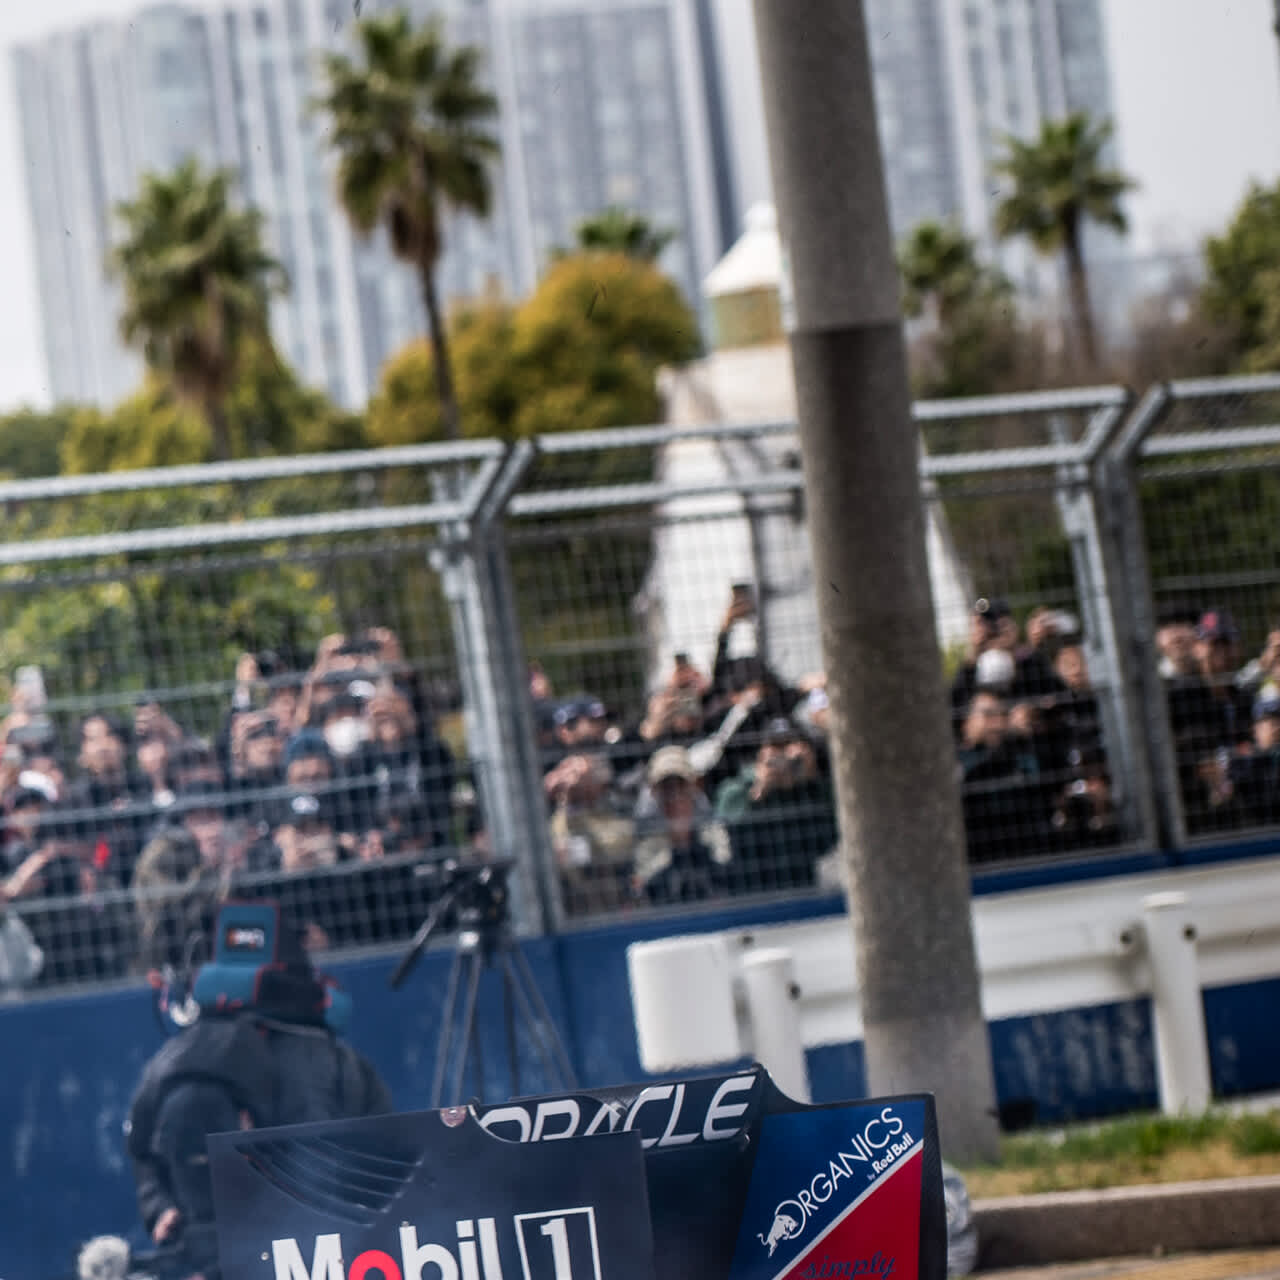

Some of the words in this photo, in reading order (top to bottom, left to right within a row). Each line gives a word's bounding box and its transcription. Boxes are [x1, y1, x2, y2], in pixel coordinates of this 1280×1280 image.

[775, 1107, 903, 1239] ORGANICS
[872, 1149, 895, 1174] Red
[890, 1132, 914, 1157] Bull
